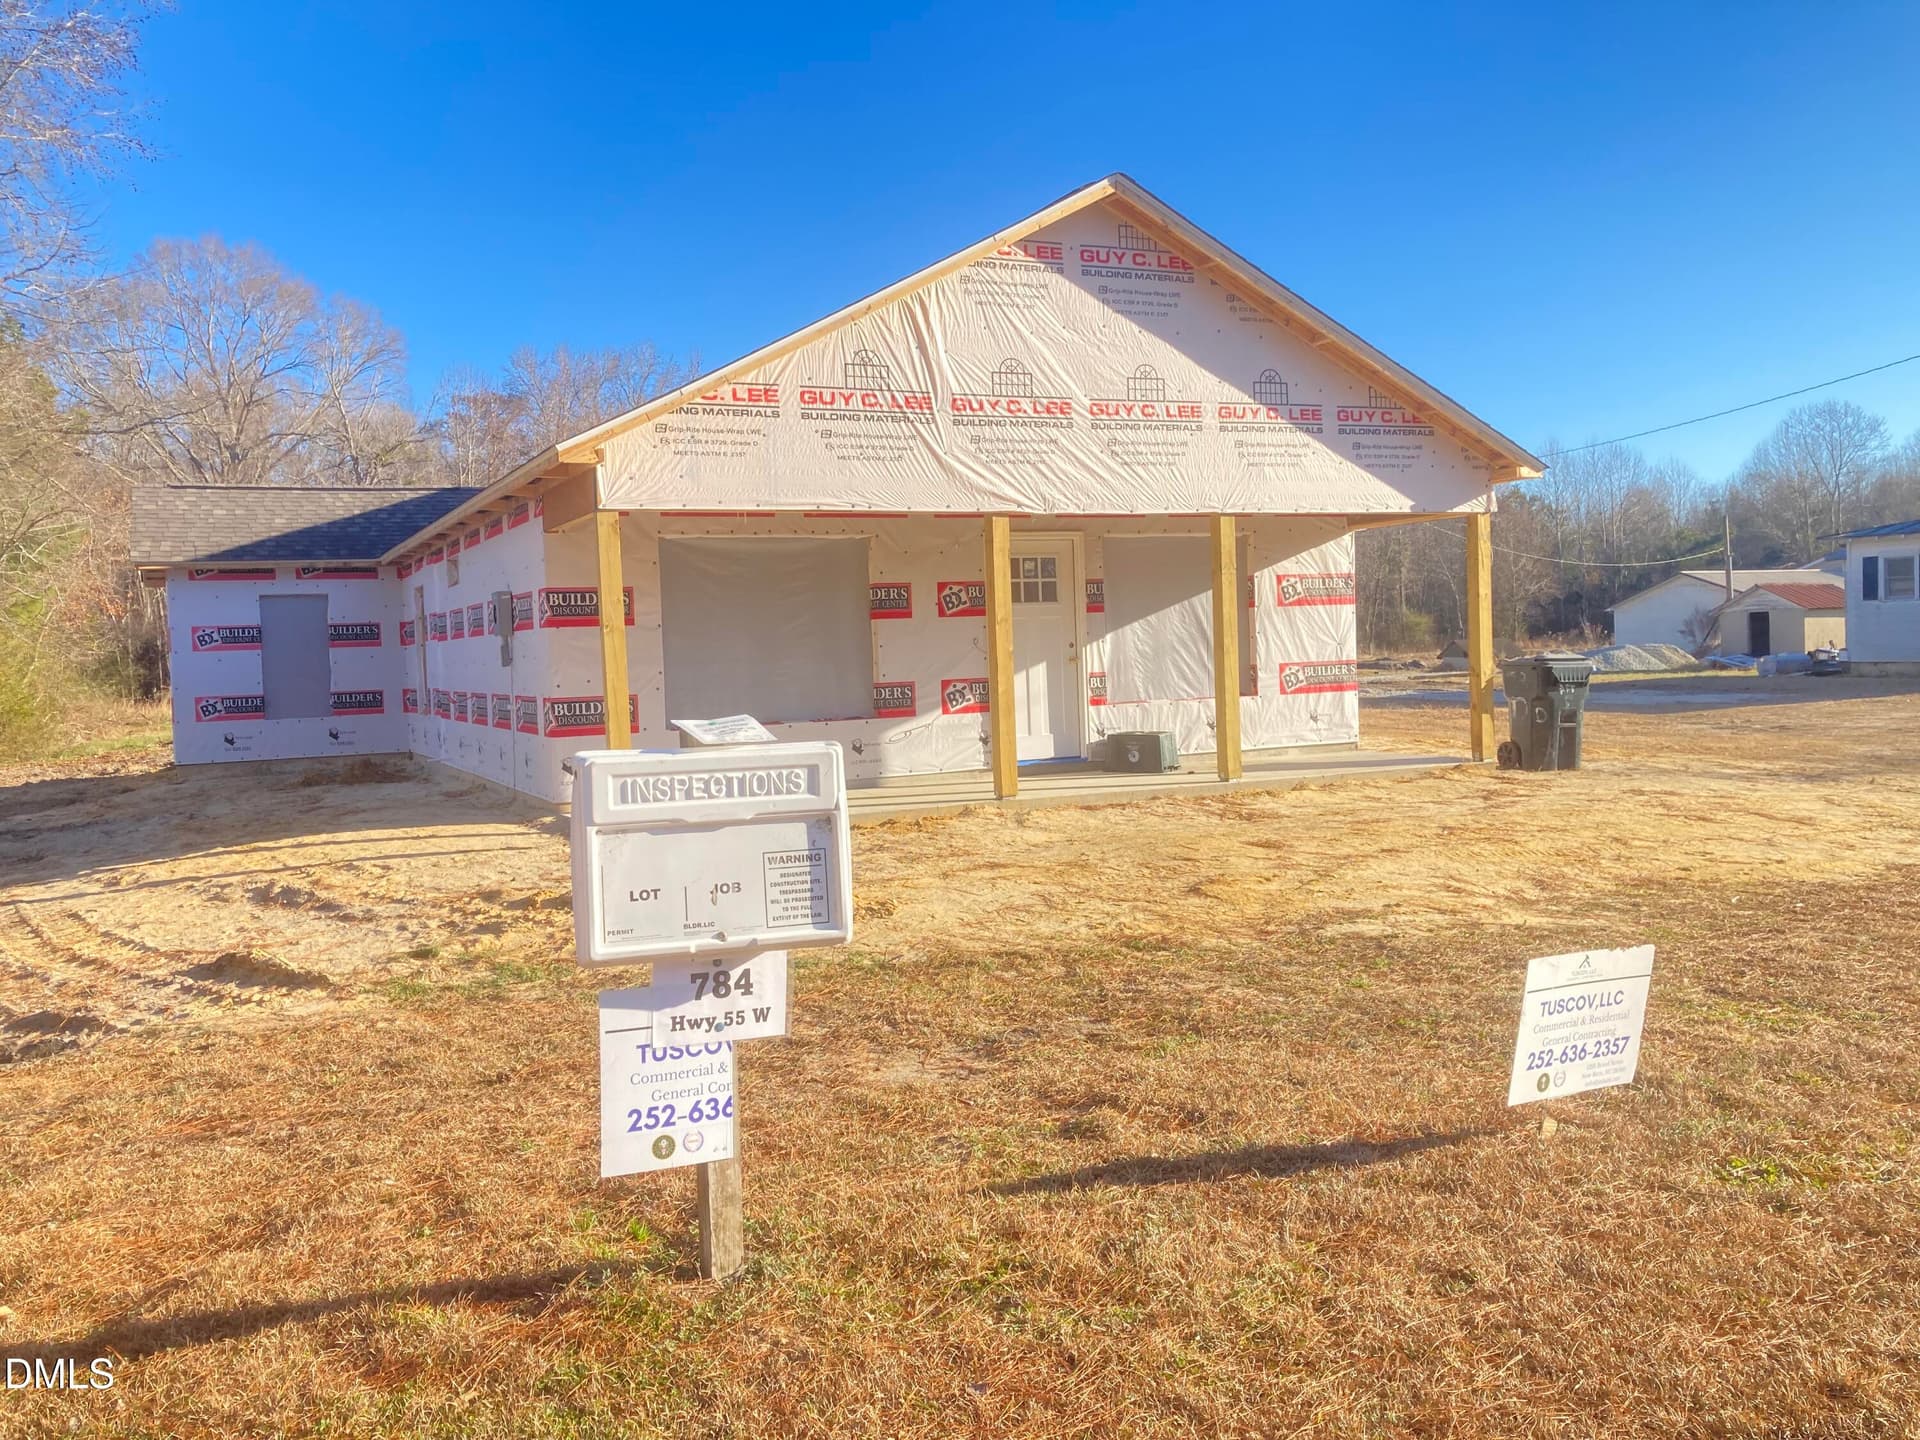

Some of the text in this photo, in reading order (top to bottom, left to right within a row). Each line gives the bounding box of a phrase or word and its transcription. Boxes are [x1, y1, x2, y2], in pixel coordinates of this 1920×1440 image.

[1023, 243, 1064, 261] LEE
[1080, 248, 1127, 265] GUY
[1131, 252, 1152, 268] C.
[1000, 261, 1065, 274] MATERIALS
[1081, 268, 1133, 280] BUILDING
[1134, 271, 1195, 284] MATERIALS
[731, 386, 780, 404] LEE
[799, 388, 934, 411] GUY C. LEE
[702, 406, 780, 419] MATERIALS
[950, 396, 1072, 416] GUY C. LEE
[1089, 402, 1202, 419] GUY C. LEE
[1217, 405, 1262, 420] GUY
[1288, 407, 1323, 421] LEE
[800, 411, 937, 426] BUILDING MATERIALS
[952, 417, 1074, 430] BUILDING MATERIALS
[1336, 409, 1377, 423] GUY
[1381, 410, 1398, 424] C.
[1091, 421, 1203, 432] BUILDING MATERIALS
[1219, 424, 1323, 435] BUILDING MATERIALS
[1338, 427, 1435, 437] BUILDING MATERIALS
[553, 605, 596, 615] DISCOUNT
[558, 714, 600, 726] DISCOUNT
[621, 767, 806, 804] INSPECTIONS
[767, 852, 823, 866] WARNING
[769, 880, 809, 888] CONSTRUCTION
[629, 887, 661, 903] LOT
[607, 928, 634, 937] PERMIT
[690, 968, 754, 1001] 784
[1540, 990, 1625, 1018] TUSCOV,LLC
[723, 1010, 746, 1027] 55
[752, 1006, 772, 1023] W
[1533, 1009, 1631, 1035] Commercial & Residential
[1542, 1027, 1617, 1048] General Contracting
[1526, 1035, 1632, 1072] 252-636-2357
[630, 1061, 729, 1086] Commercial &
[651, 1082, 704, 1102] General
[626, 1095, 733, 1133] 252-636
